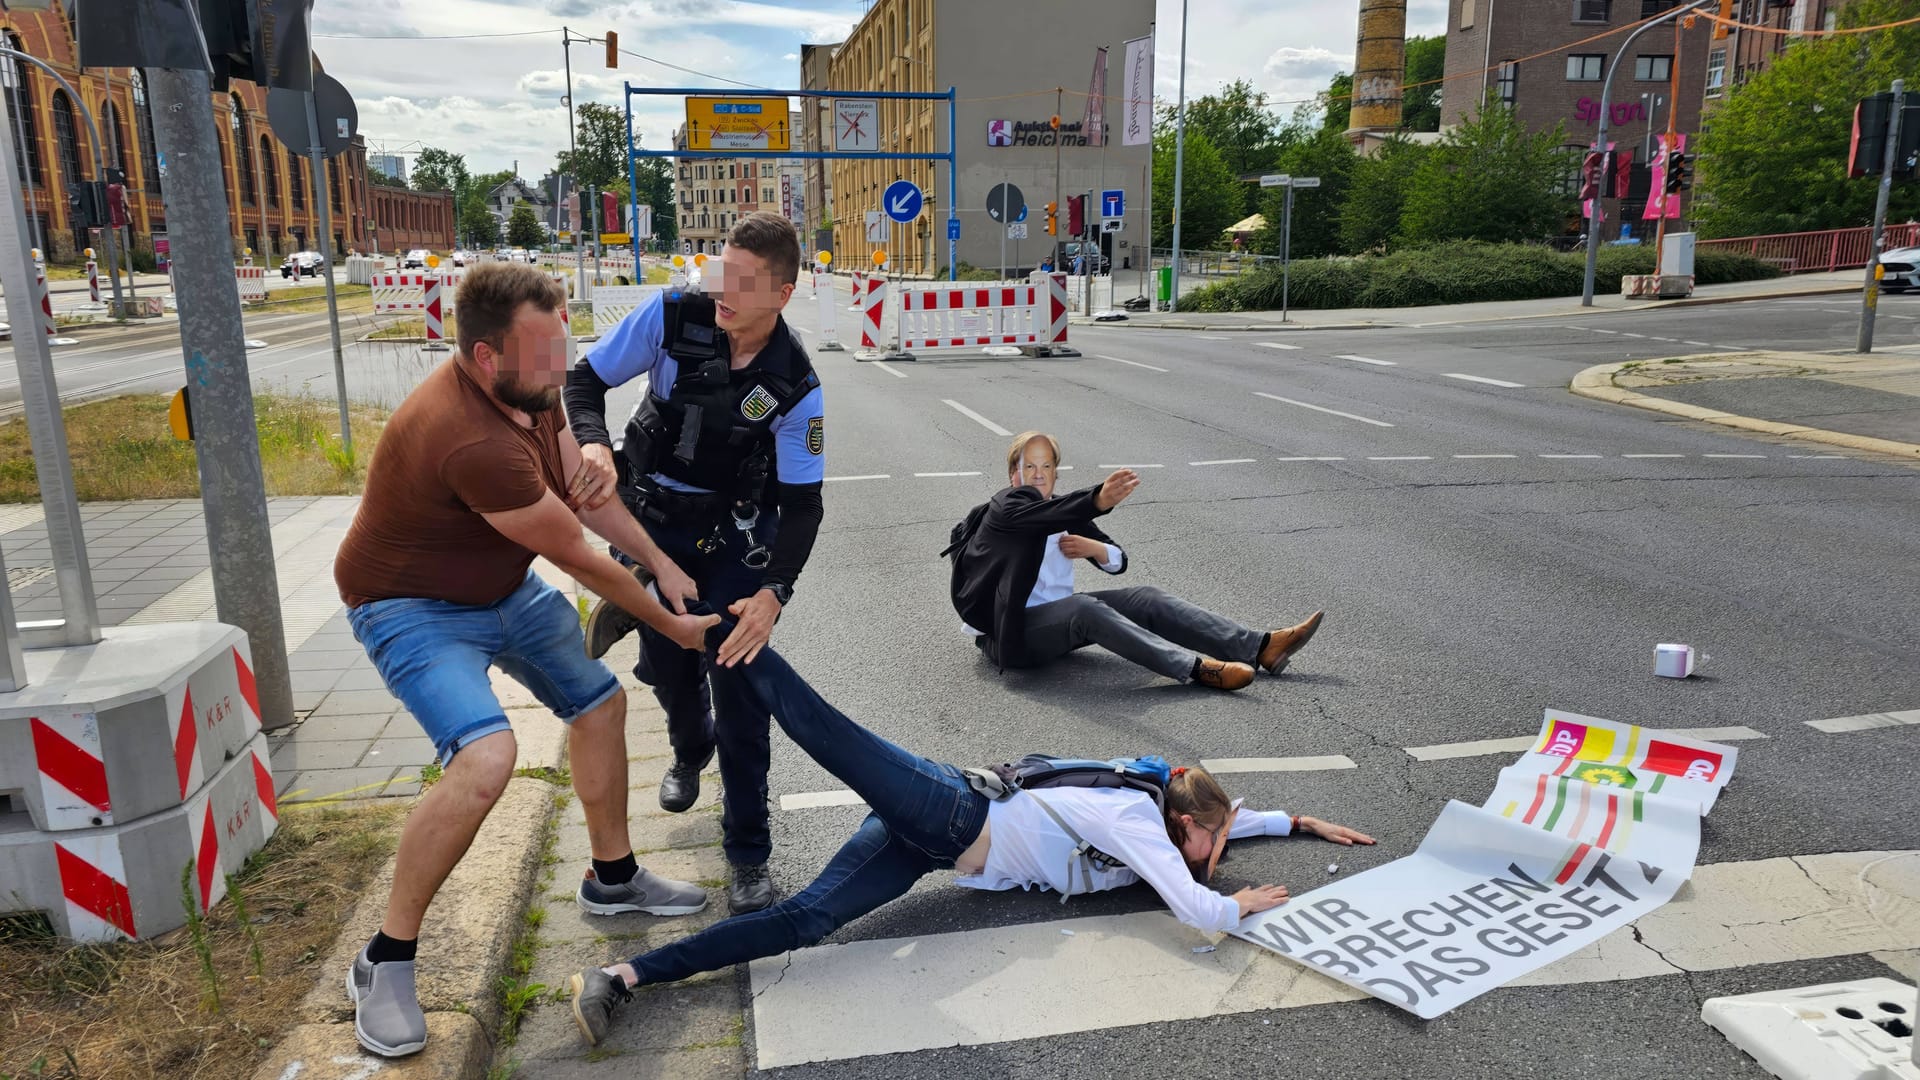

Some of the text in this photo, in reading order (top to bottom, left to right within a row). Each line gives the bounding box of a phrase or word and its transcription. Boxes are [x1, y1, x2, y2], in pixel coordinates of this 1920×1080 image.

[206, 696, 232, 731] K&R
[1684, 758, 1715, 782] PD
[226, 801, 251, 841] K&R
[1246, 898, 1371, 954] WIR
[1302, 862, 1552, 977] BRECHEN
[1362, 852, 1664, 1007] DAS GESET
